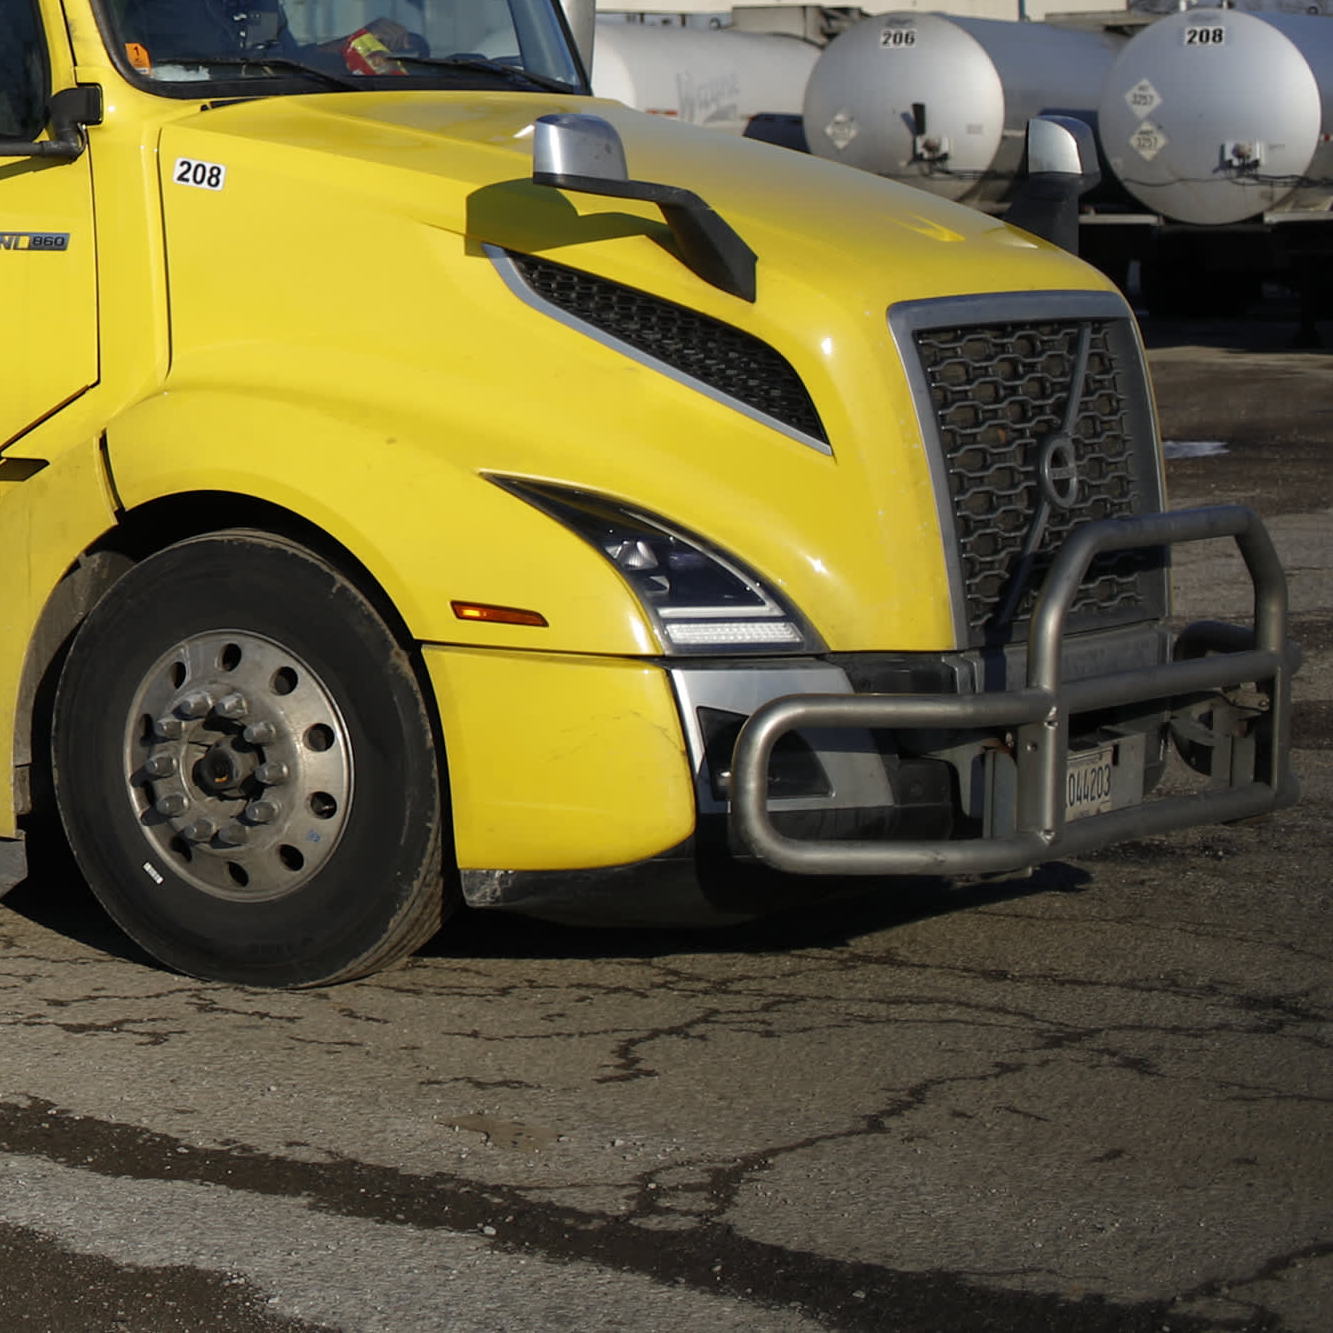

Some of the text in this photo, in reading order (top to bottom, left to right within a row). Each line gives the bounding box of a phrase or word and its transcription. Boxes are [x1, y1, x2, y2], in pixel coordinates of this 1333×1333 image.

[882, 30, 915, 46] 206
[1187, 28, 1224, 45] 208
[177, 160, 222, 188] 208
